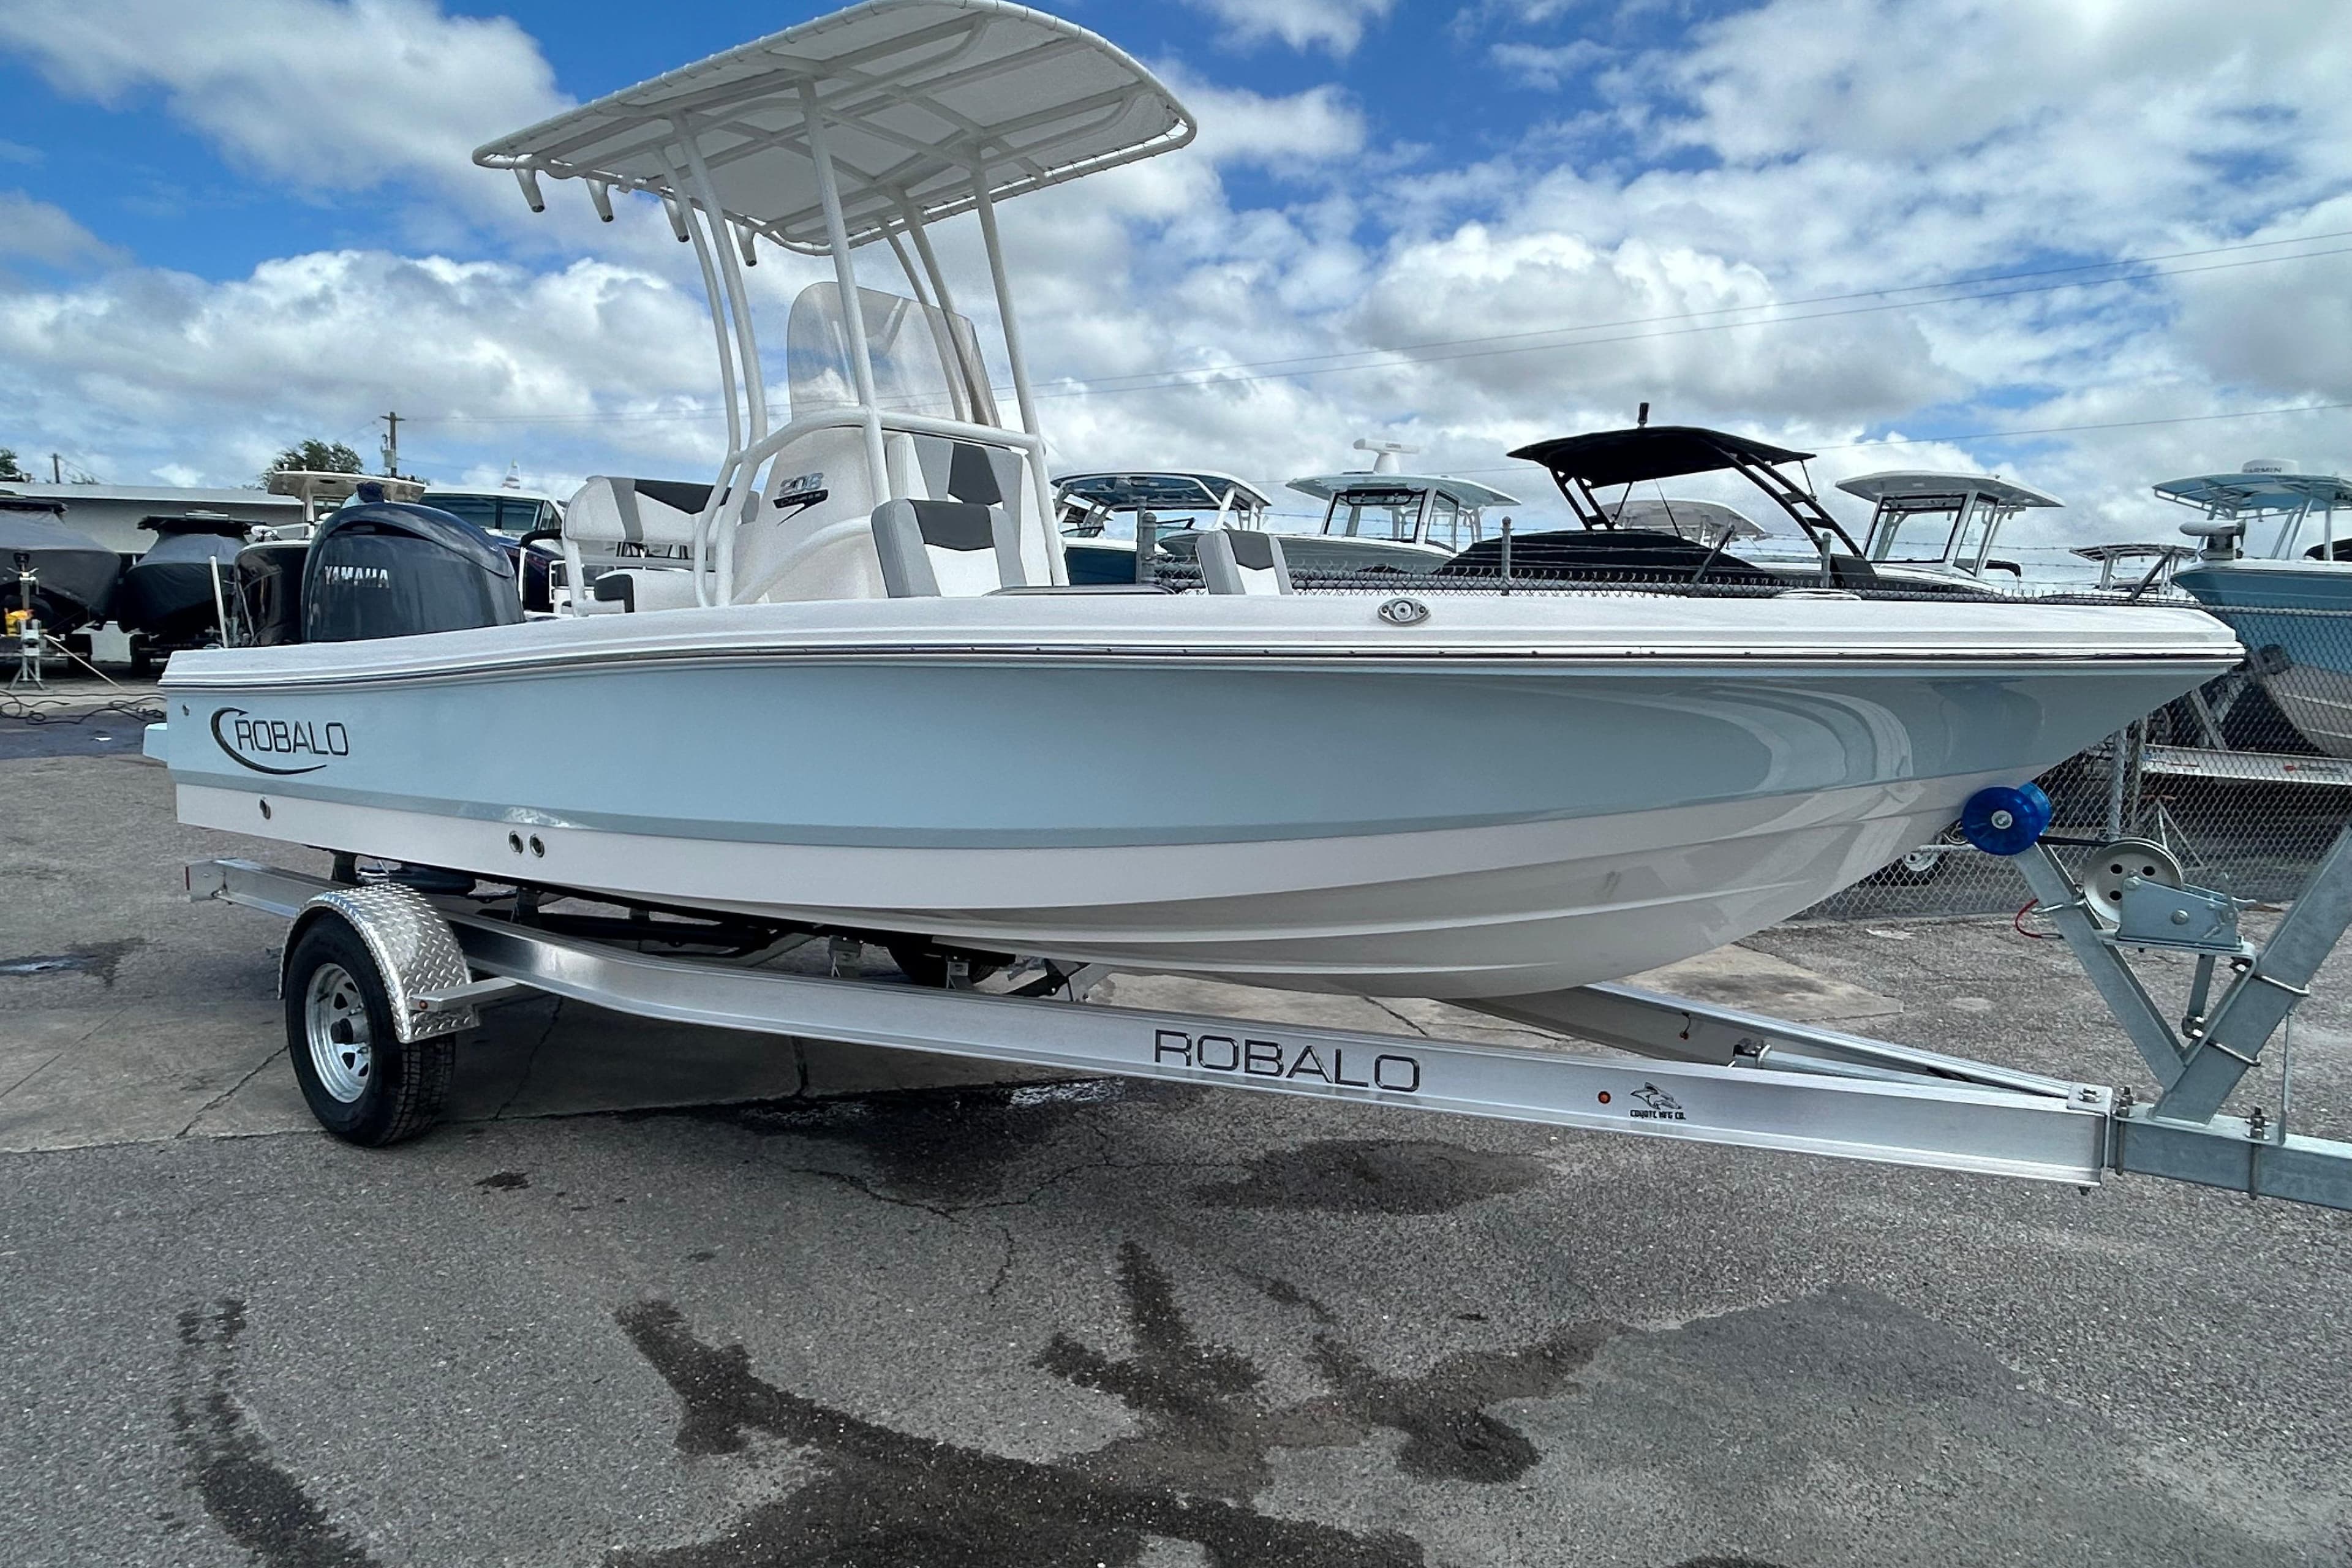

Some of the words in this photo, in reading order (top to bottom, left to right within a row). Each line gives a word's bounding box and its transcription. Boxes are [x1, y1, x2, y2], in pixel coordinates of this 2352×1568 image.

[778, 472, 824, 497] 206
[324, 565, 390, 588] YAMAHA
[235, 719, 349, 756] ROBALO
[1155, 1029, 1420, 1092] ROBALO
